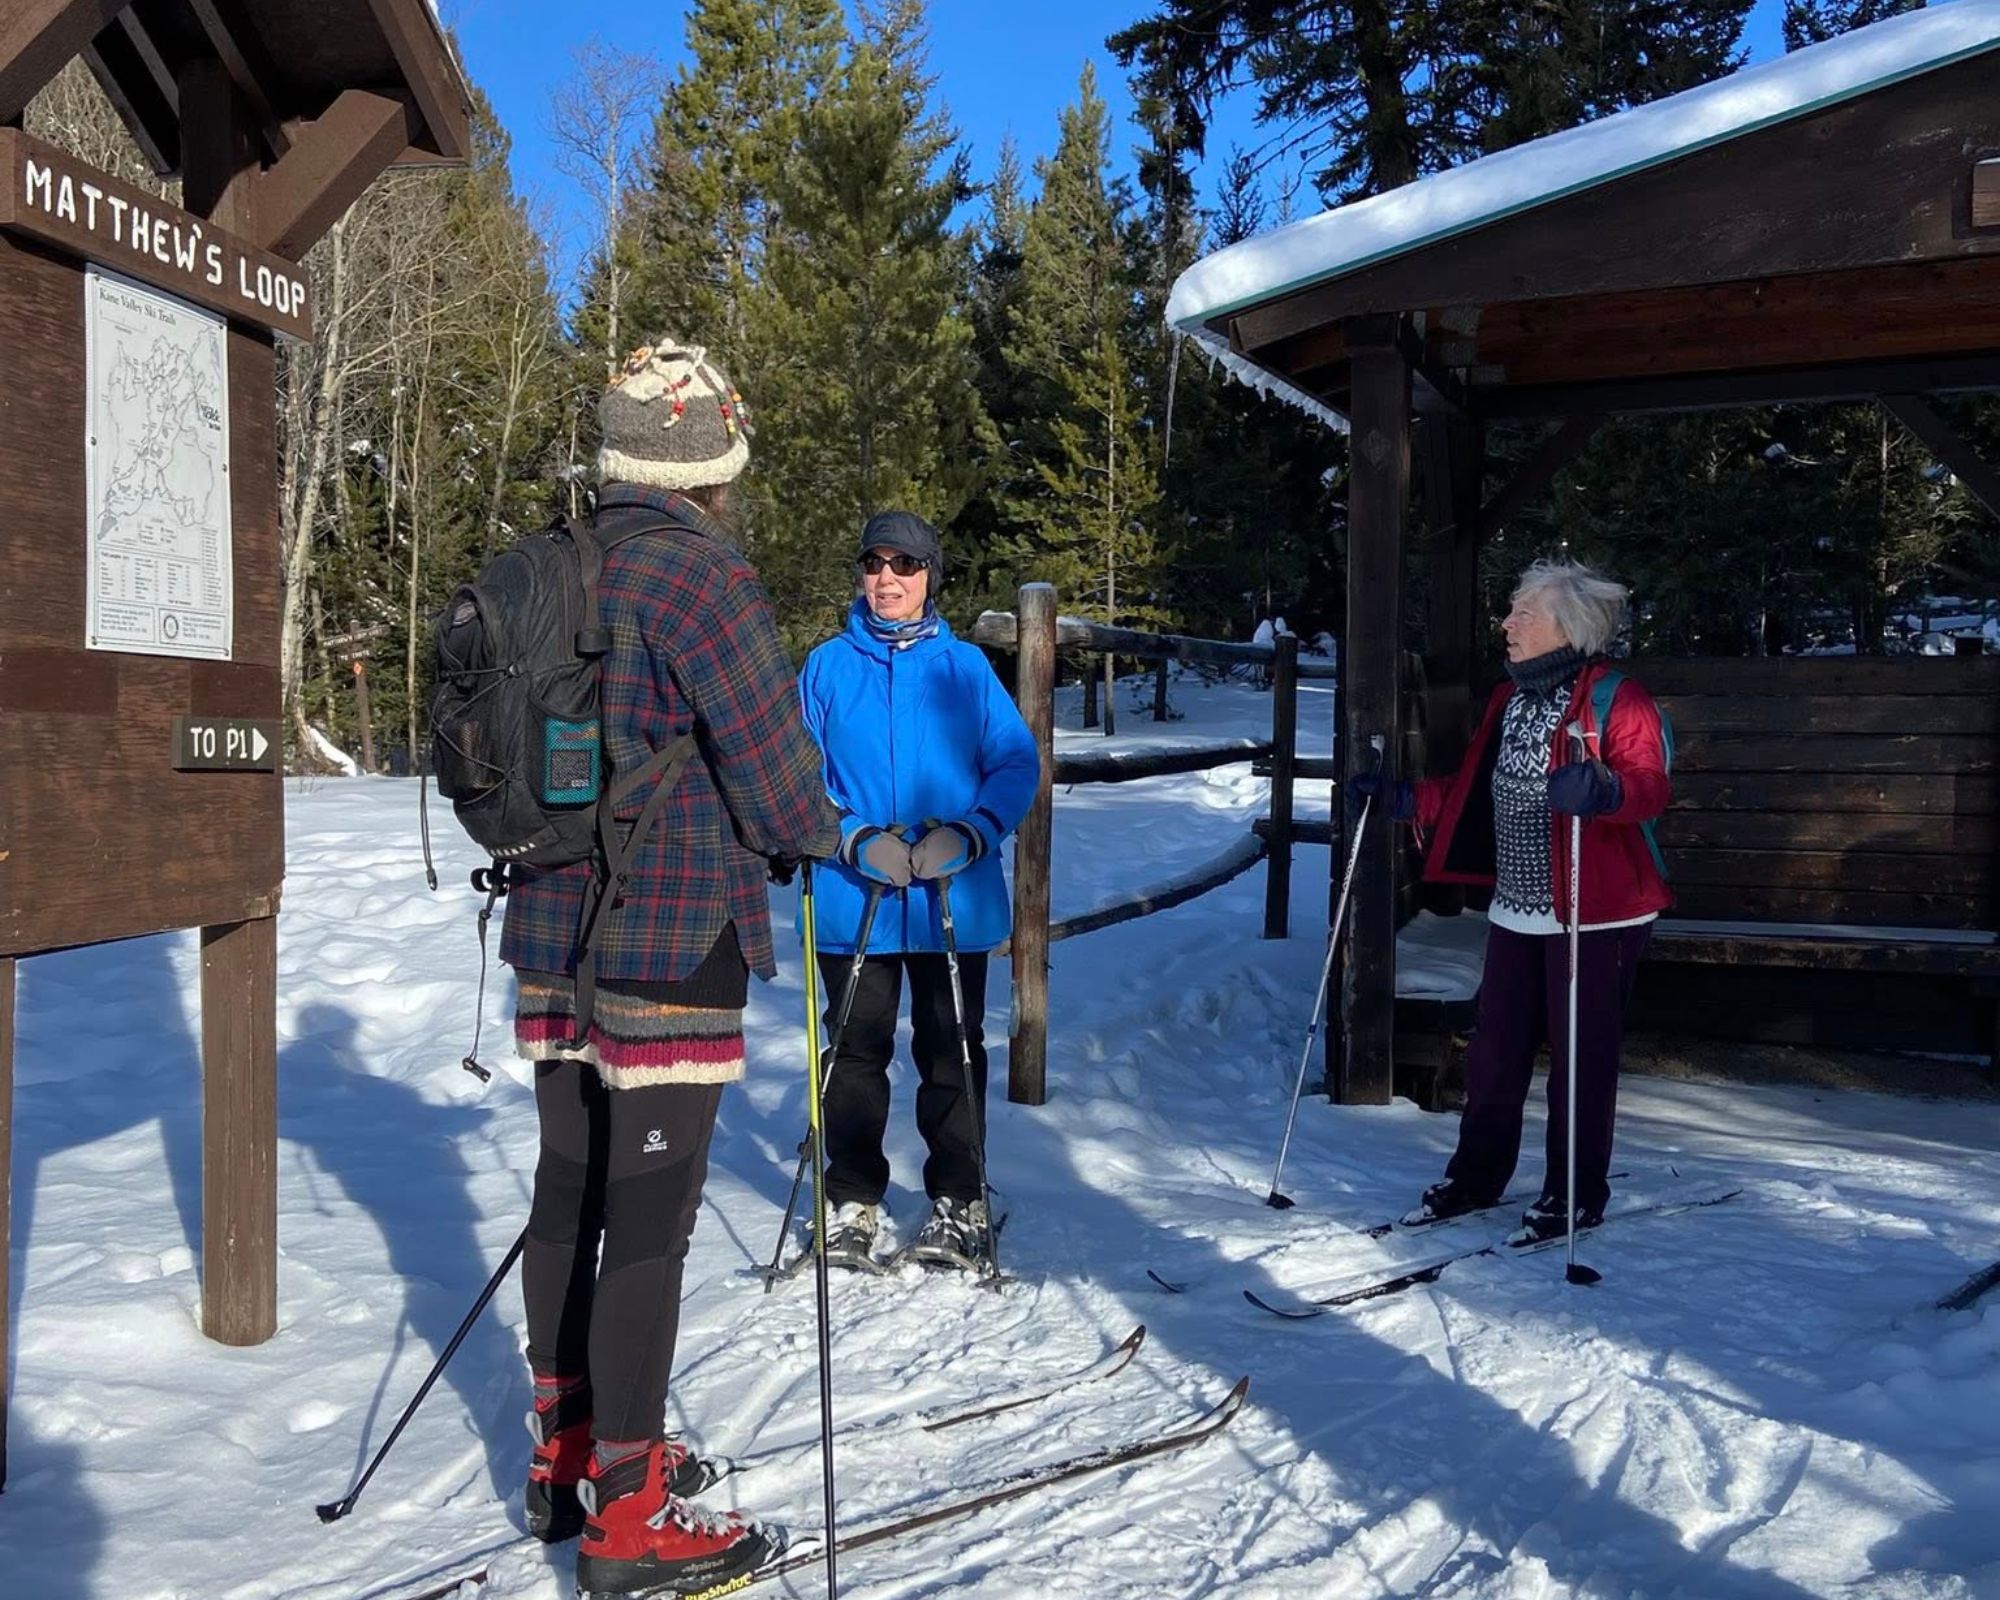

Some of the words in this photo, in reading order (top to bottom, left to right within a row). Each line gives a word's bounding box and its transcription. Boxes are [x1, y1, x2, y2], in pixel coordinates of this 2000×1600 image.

[26, 159, 223, 286] MATTHEW'S
[239, 256, 306, 319] LOOP
[121, 295, 143, 315] Valley
[144, 303, 157, 318] Ski
[190, 726, 216, 758] TO
